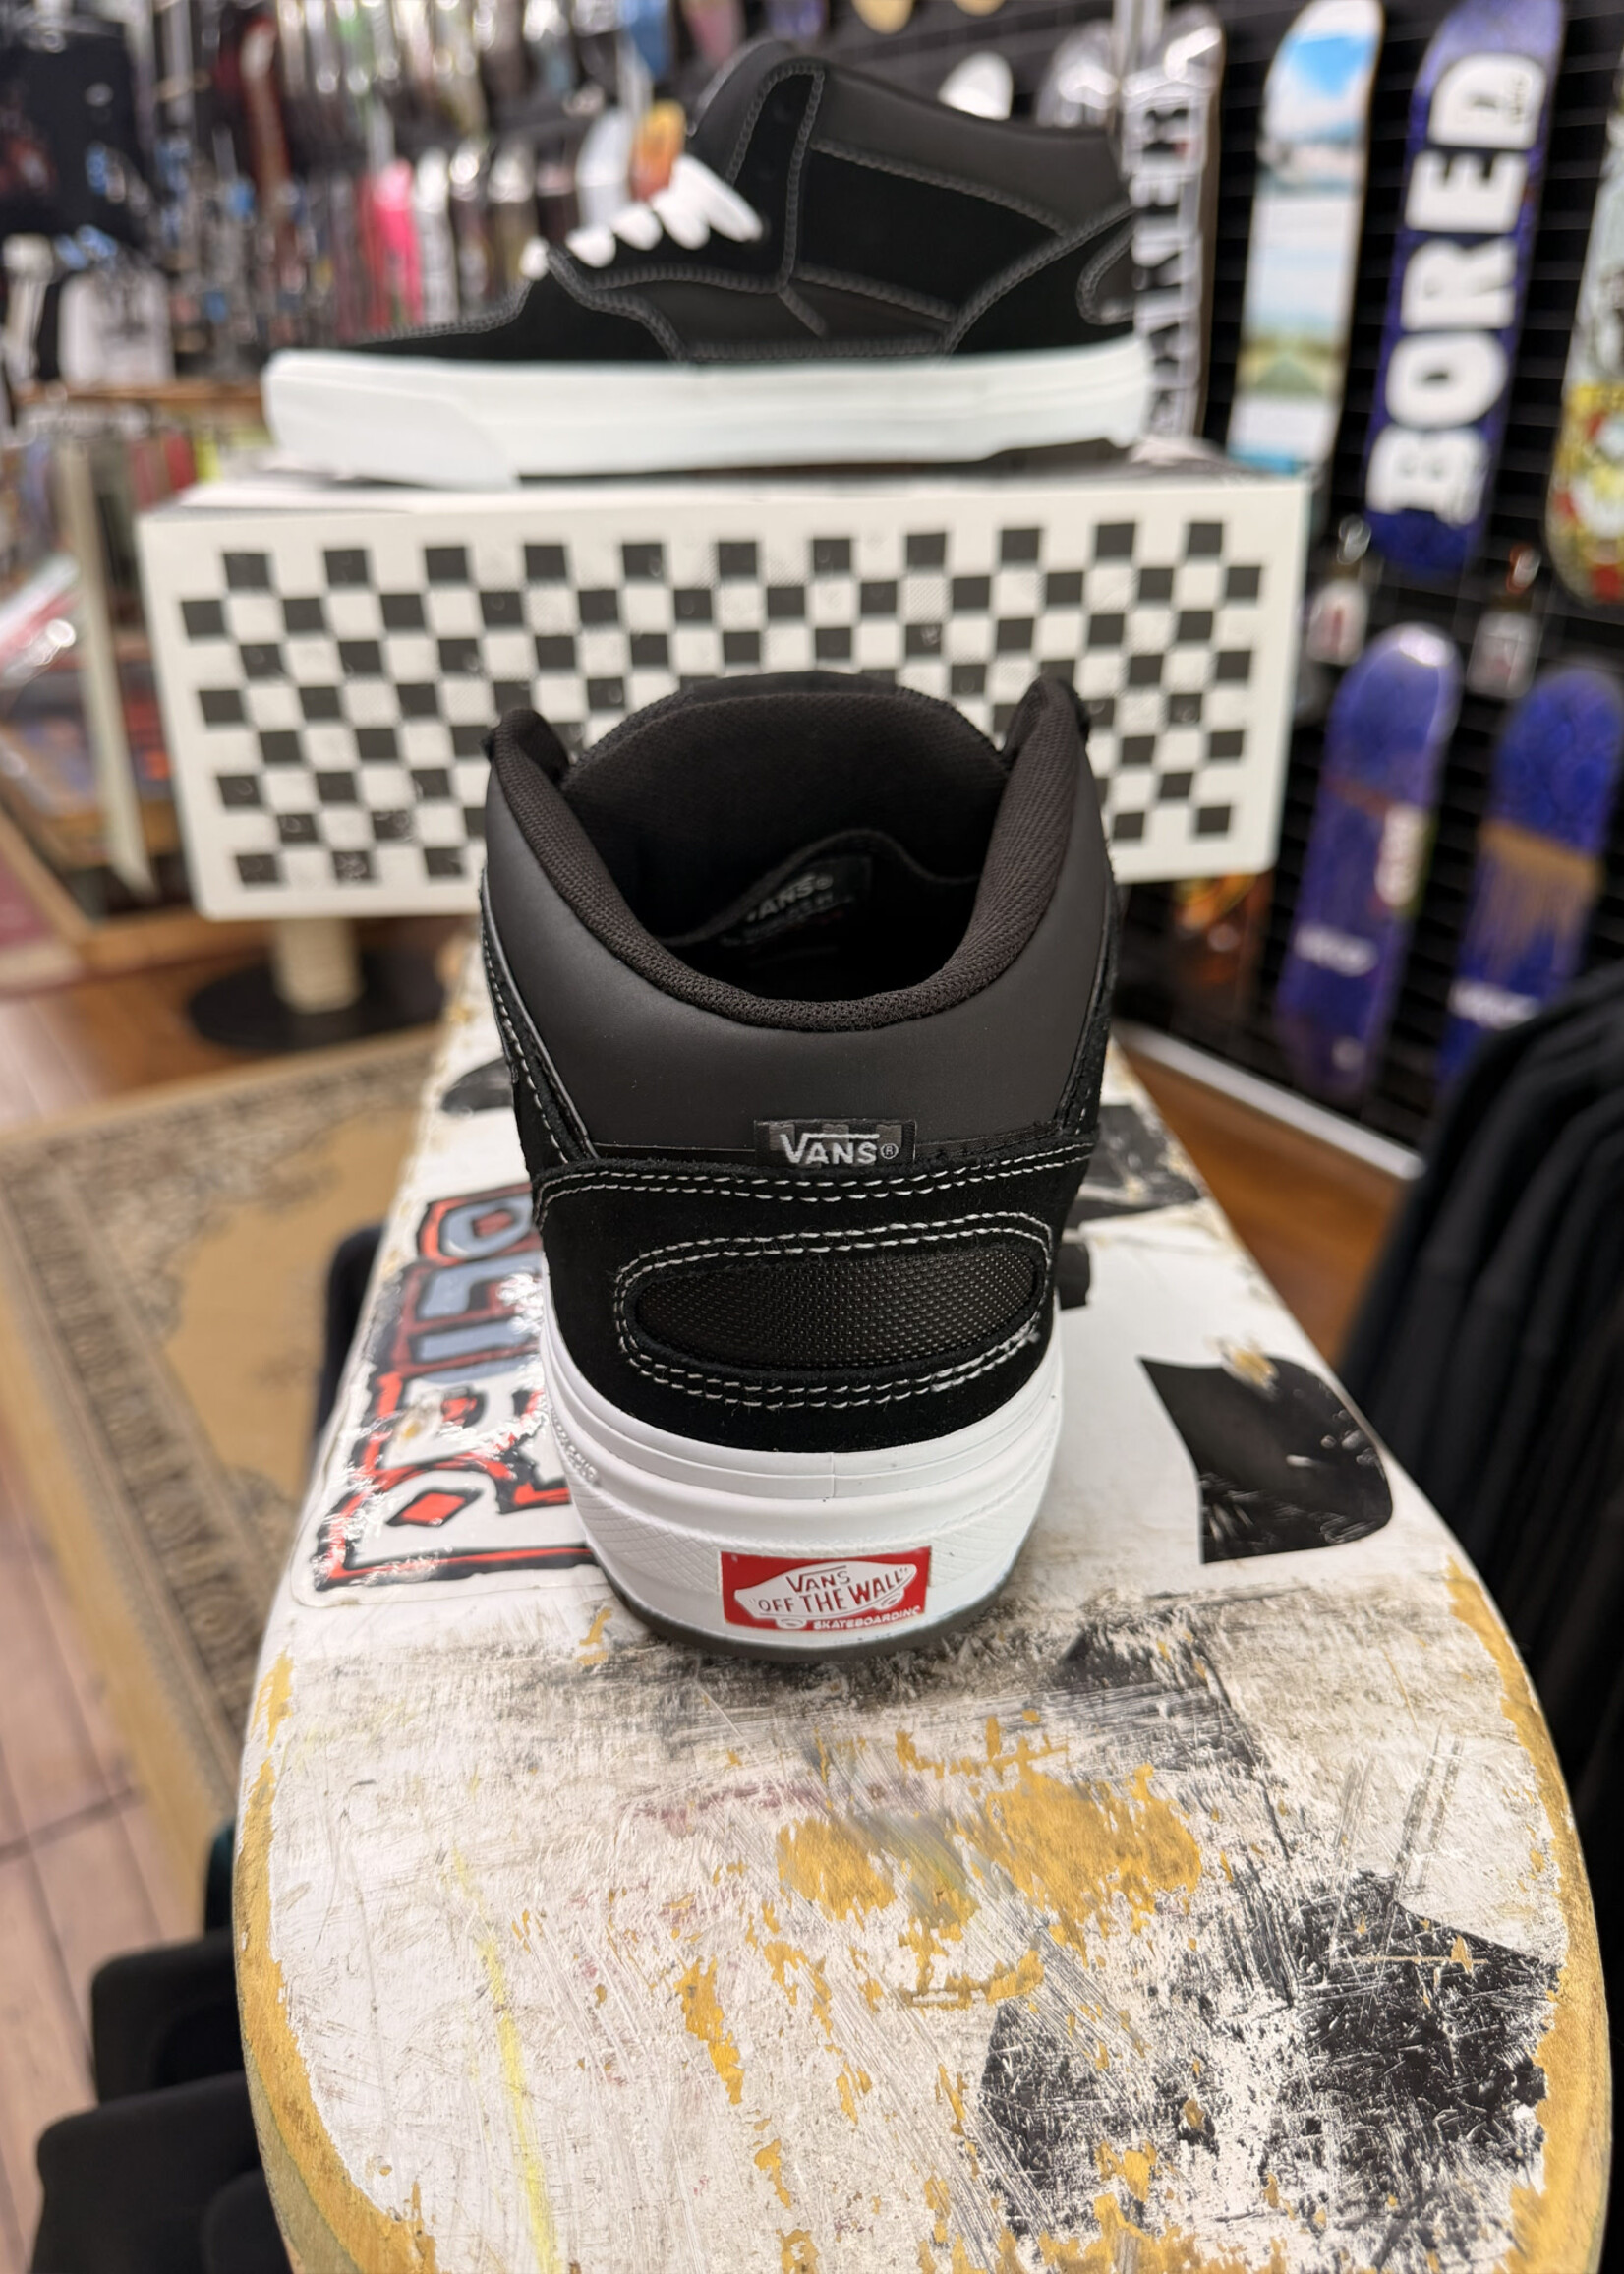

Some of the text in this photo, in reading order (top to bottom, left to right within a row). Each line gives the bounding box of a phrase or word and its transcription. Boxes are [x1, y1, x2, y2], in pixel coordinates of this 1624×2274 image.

[1365, 52, 1546, 527] BORED
[747, 872, 816, 922] ANS
[785, 1565, 850, 1594] VANS
[799, 1588, 847, 1613] THE
[813, 1604, 921, 1630] SKATEBOARDING
